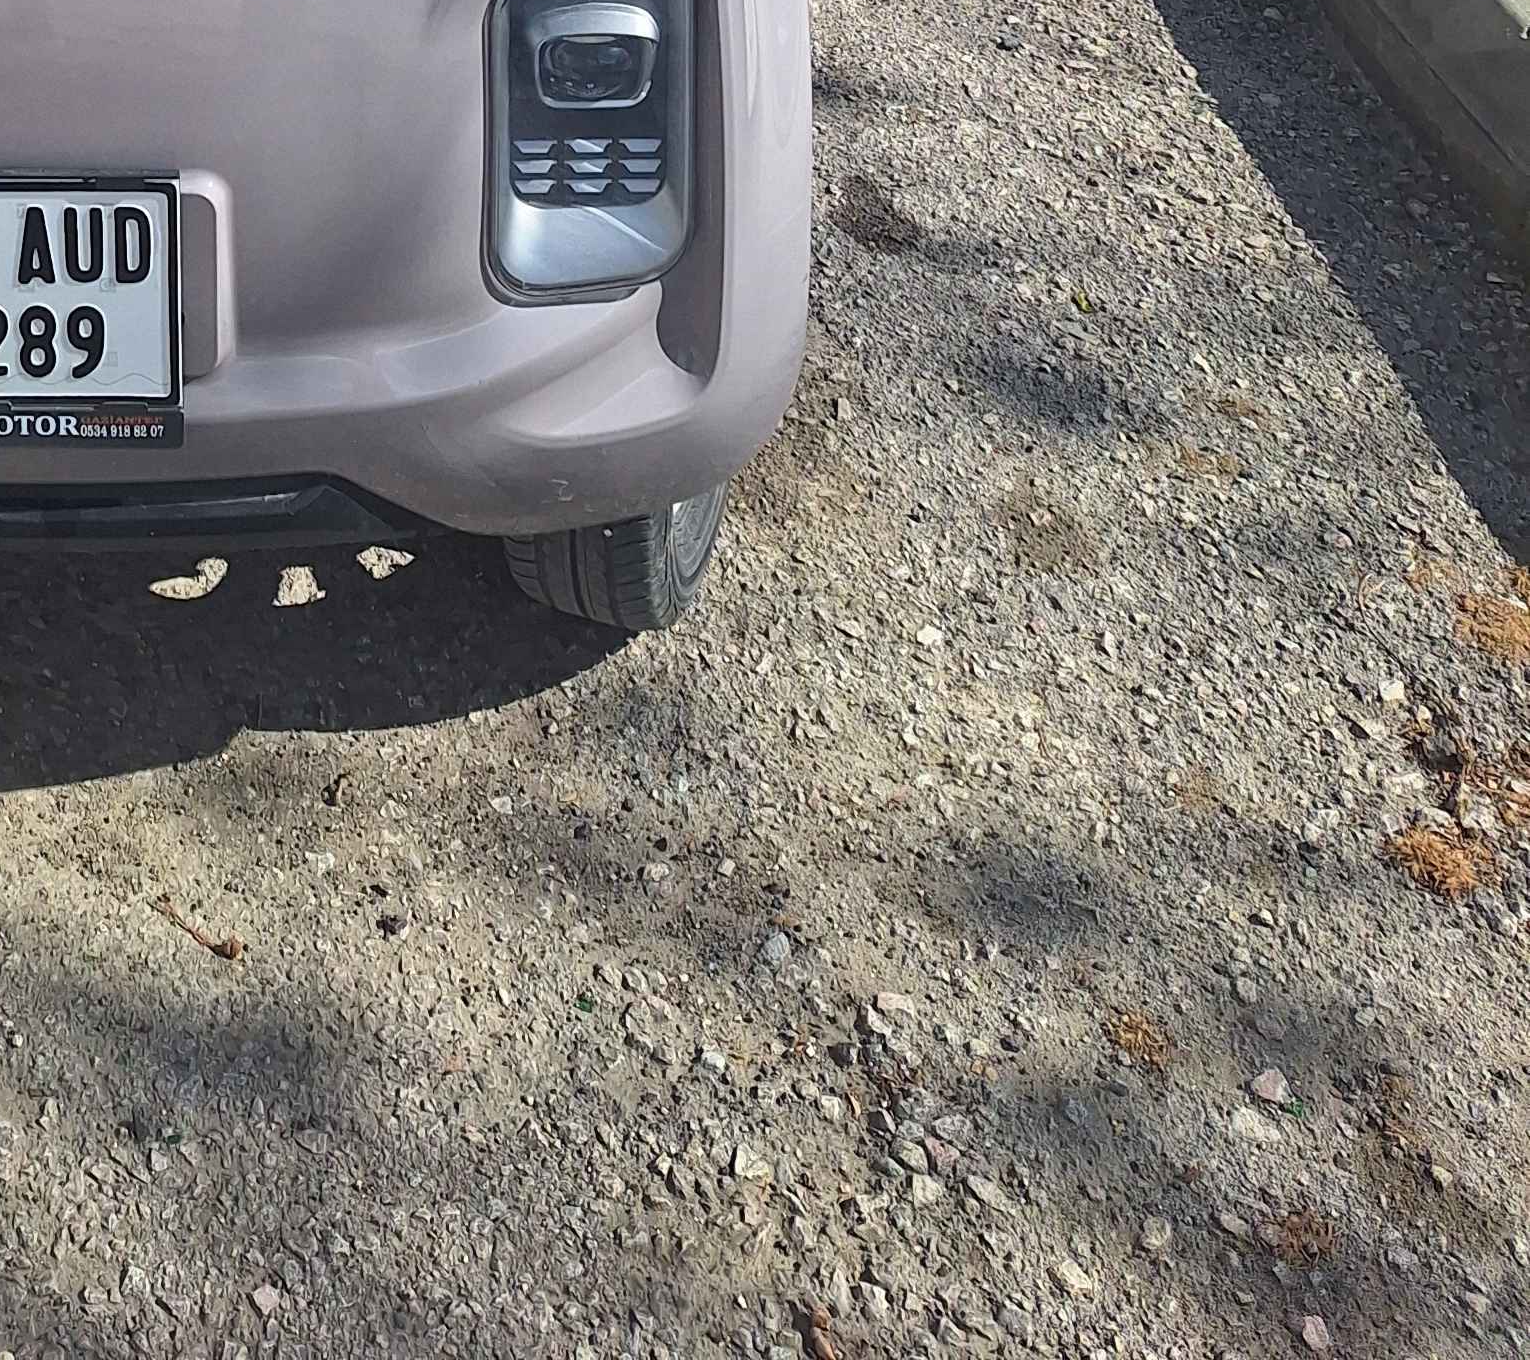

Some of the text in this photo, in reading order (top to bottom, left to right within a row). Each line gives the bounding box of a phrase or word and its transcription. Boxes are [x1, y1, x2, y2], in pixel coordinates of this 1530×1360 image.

[18, 207, 152, 284] AUD
[80, 425, 107, 437] 0534
[133, 425, 148, 437] 82
[150, 425, 164, 437] 07
